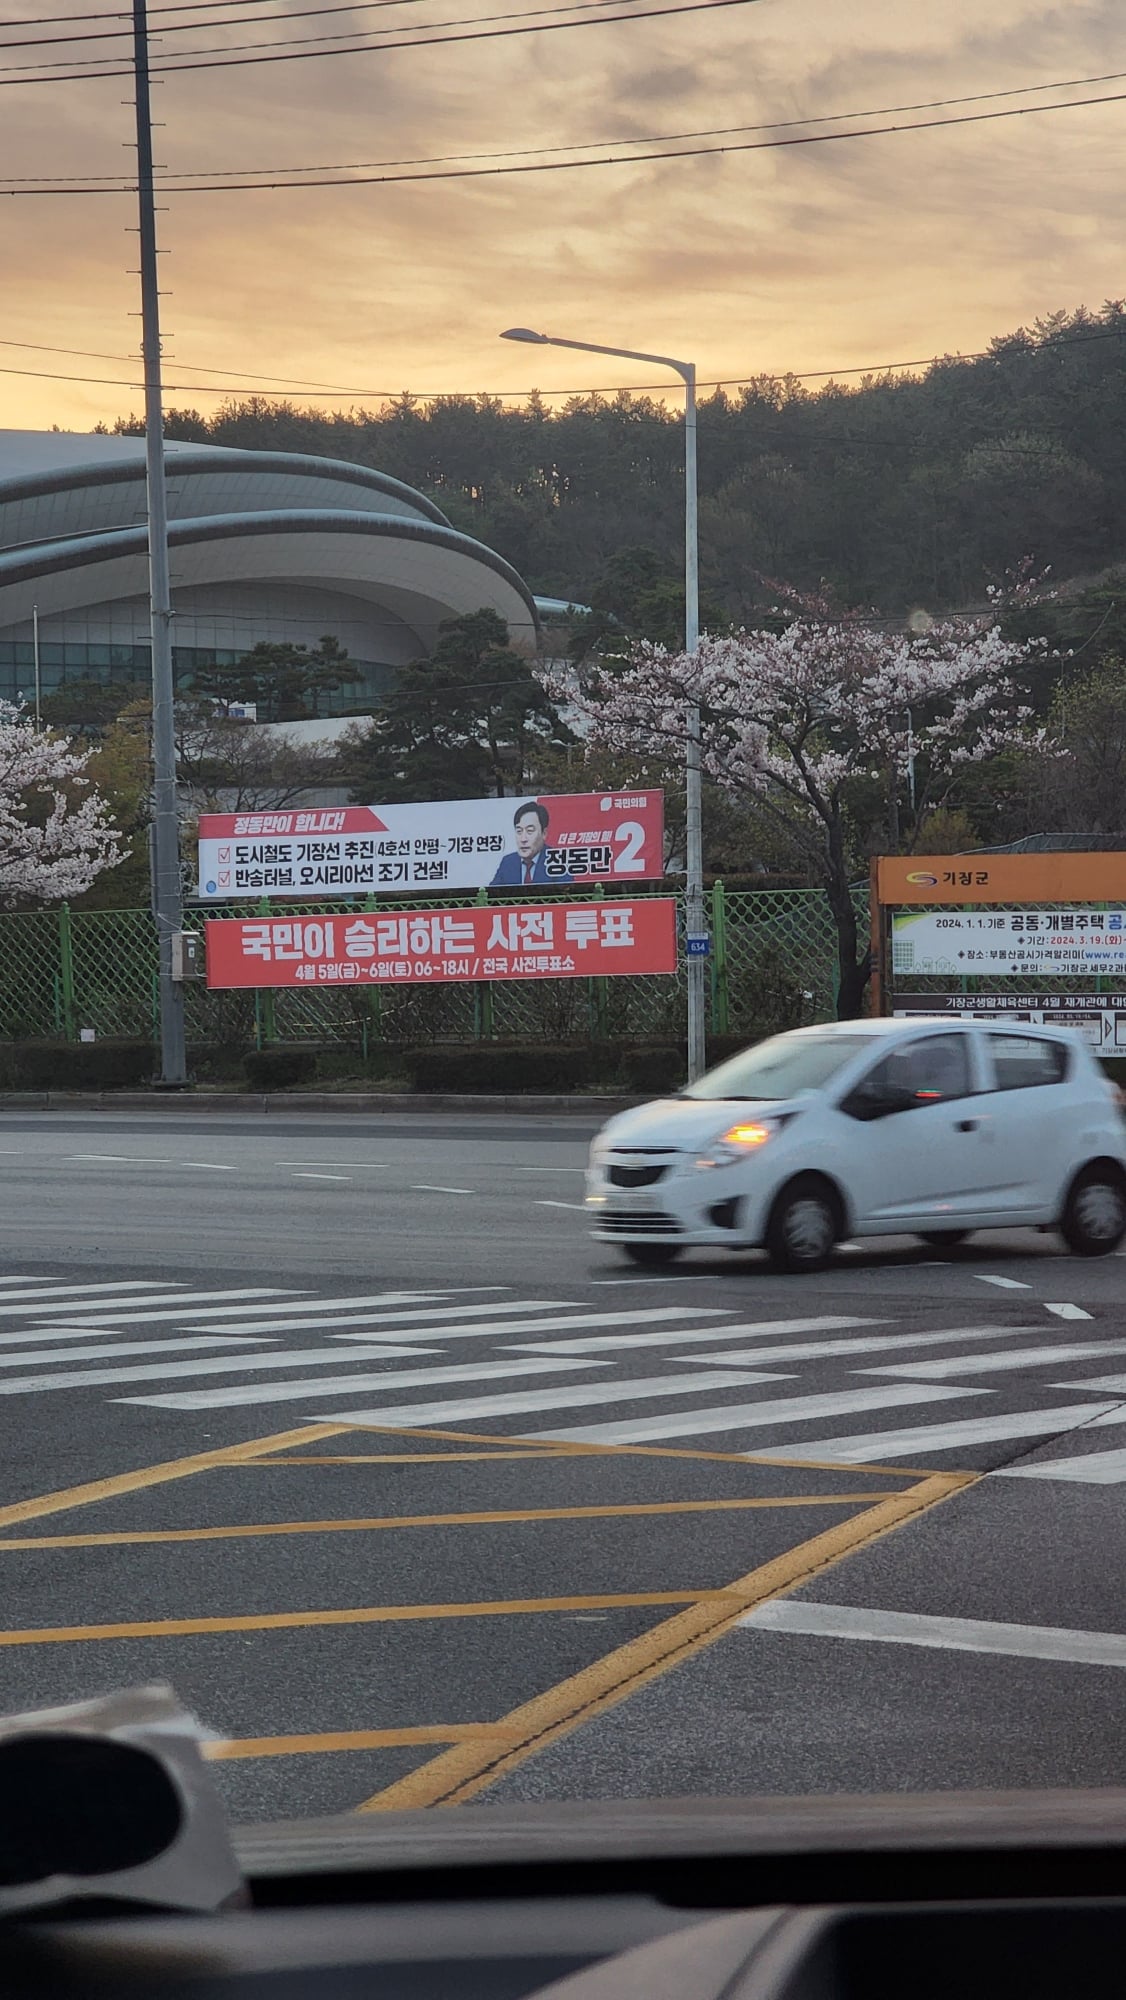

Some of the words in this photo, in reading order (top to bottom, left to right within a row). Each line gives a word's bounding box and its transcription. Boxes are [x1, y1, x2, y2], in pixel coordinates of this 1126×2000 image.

[614, 797, 647, 808] 국민의힘
[234, 814, 293, 835] 정동만이
[295, 812, 346, 832] 합니다!
[558, 832, 567, 844] 더
[614, 821, 645, 873] 2
[235, 844, 292, 864] 도시철도
[297, 842, 340, 862] 기장선
[545, 845, 613, 876] 정동만
[235, 867, 296, 888] 반송터널,
[300, 863, 374, 886] 오시리아선
[378, 862, 408, 882] 조기
[413, 861, 448, 881] 건설!
[942, 871, 989, 886] 기장군
[1108, 914, 1126, 930] 공
[242, 921, 335, 961] 국민이
[345, 916, 475, 957] 승리하는
[487, 911, 554, 951] 사전
[565, 908, 635, 949] 투표
[691, 942, 705, 951] 634
[295, 963, 316, 980] 4월
[415, 959, 469, 977] 06~18시
[483, 957, 508, 974] 전국
[511, 955, 575, 973] 사전투표소
[945, 996, 1038, 1008] 기장군생활체육센터
[1042, 996, 1060, 1008] 4월
[1111, 996, 1126, 1008] 대
